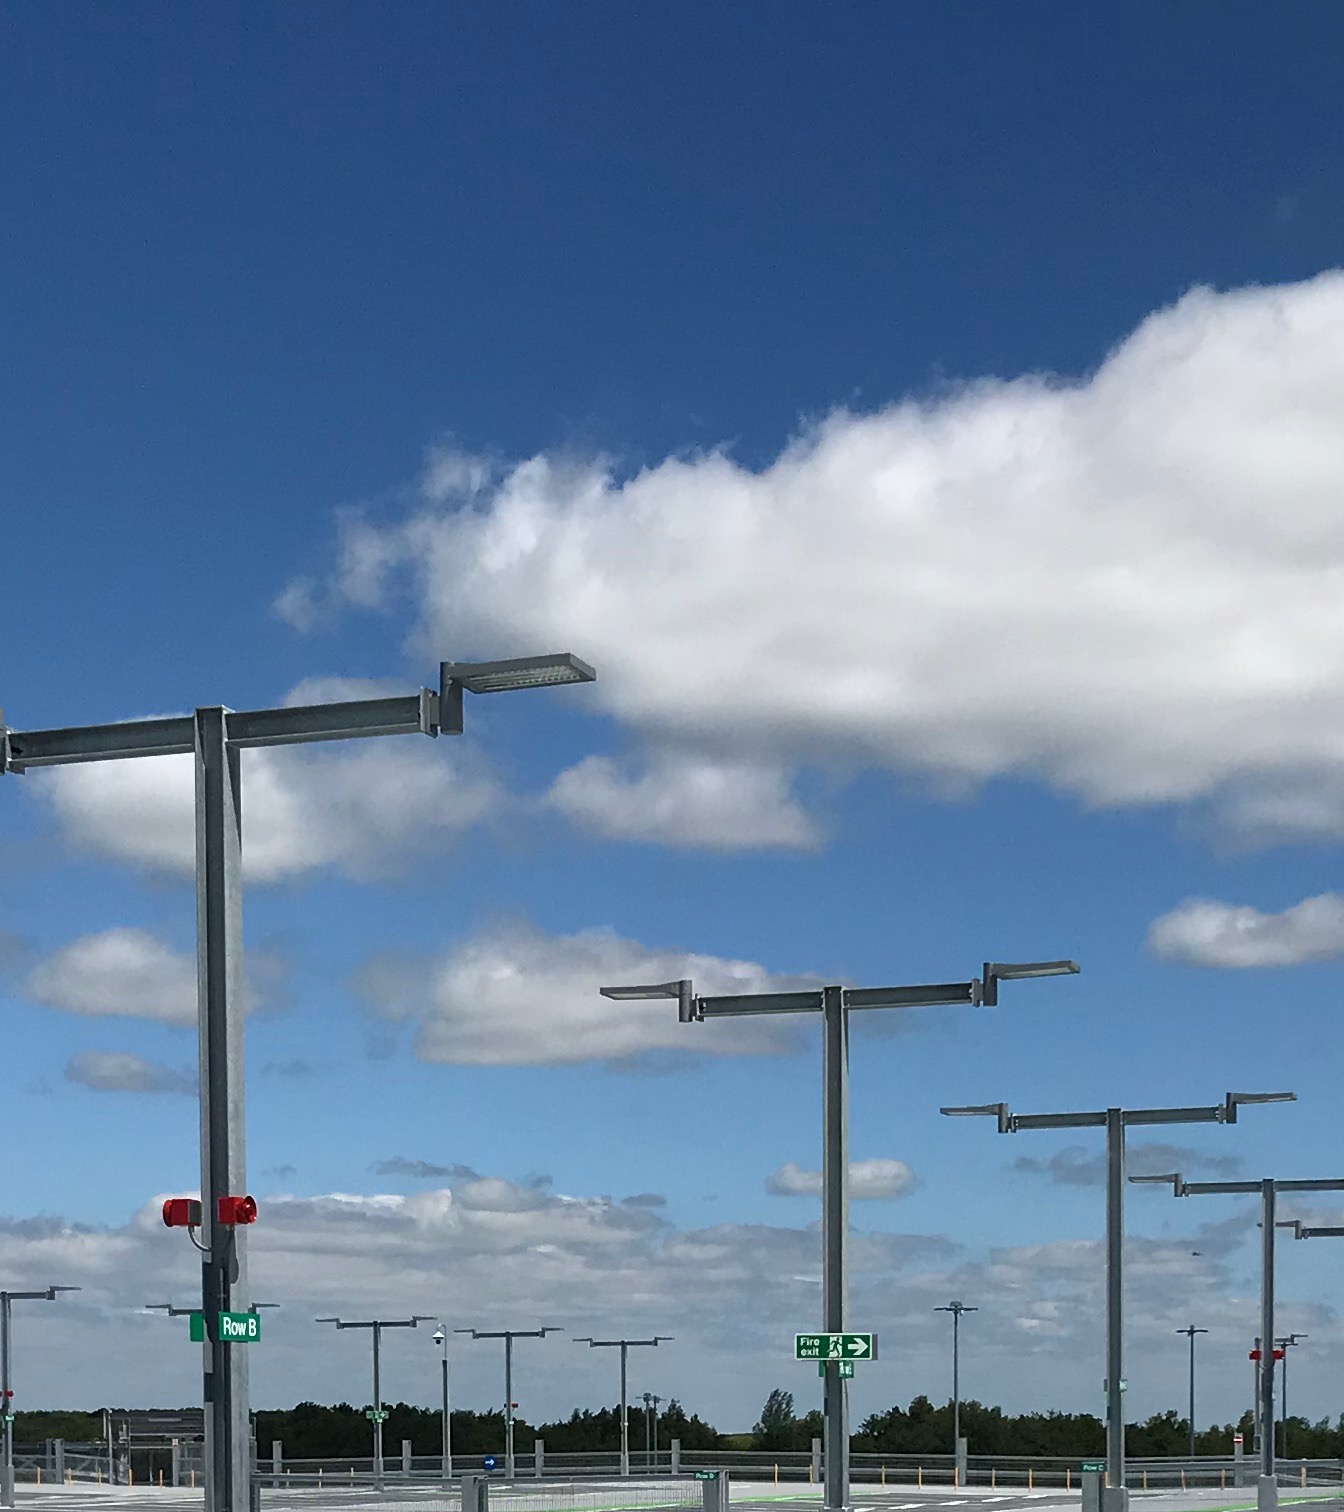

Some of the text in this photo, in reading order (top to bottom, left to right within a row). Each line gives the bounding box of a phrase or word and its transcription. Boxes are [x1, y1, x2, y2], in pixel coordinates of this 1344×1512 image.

[223, 1317, 257, 1337] Row B
[800, 1337, 820, 1346] Fire
[800, 1348, 820, 1356] exit
